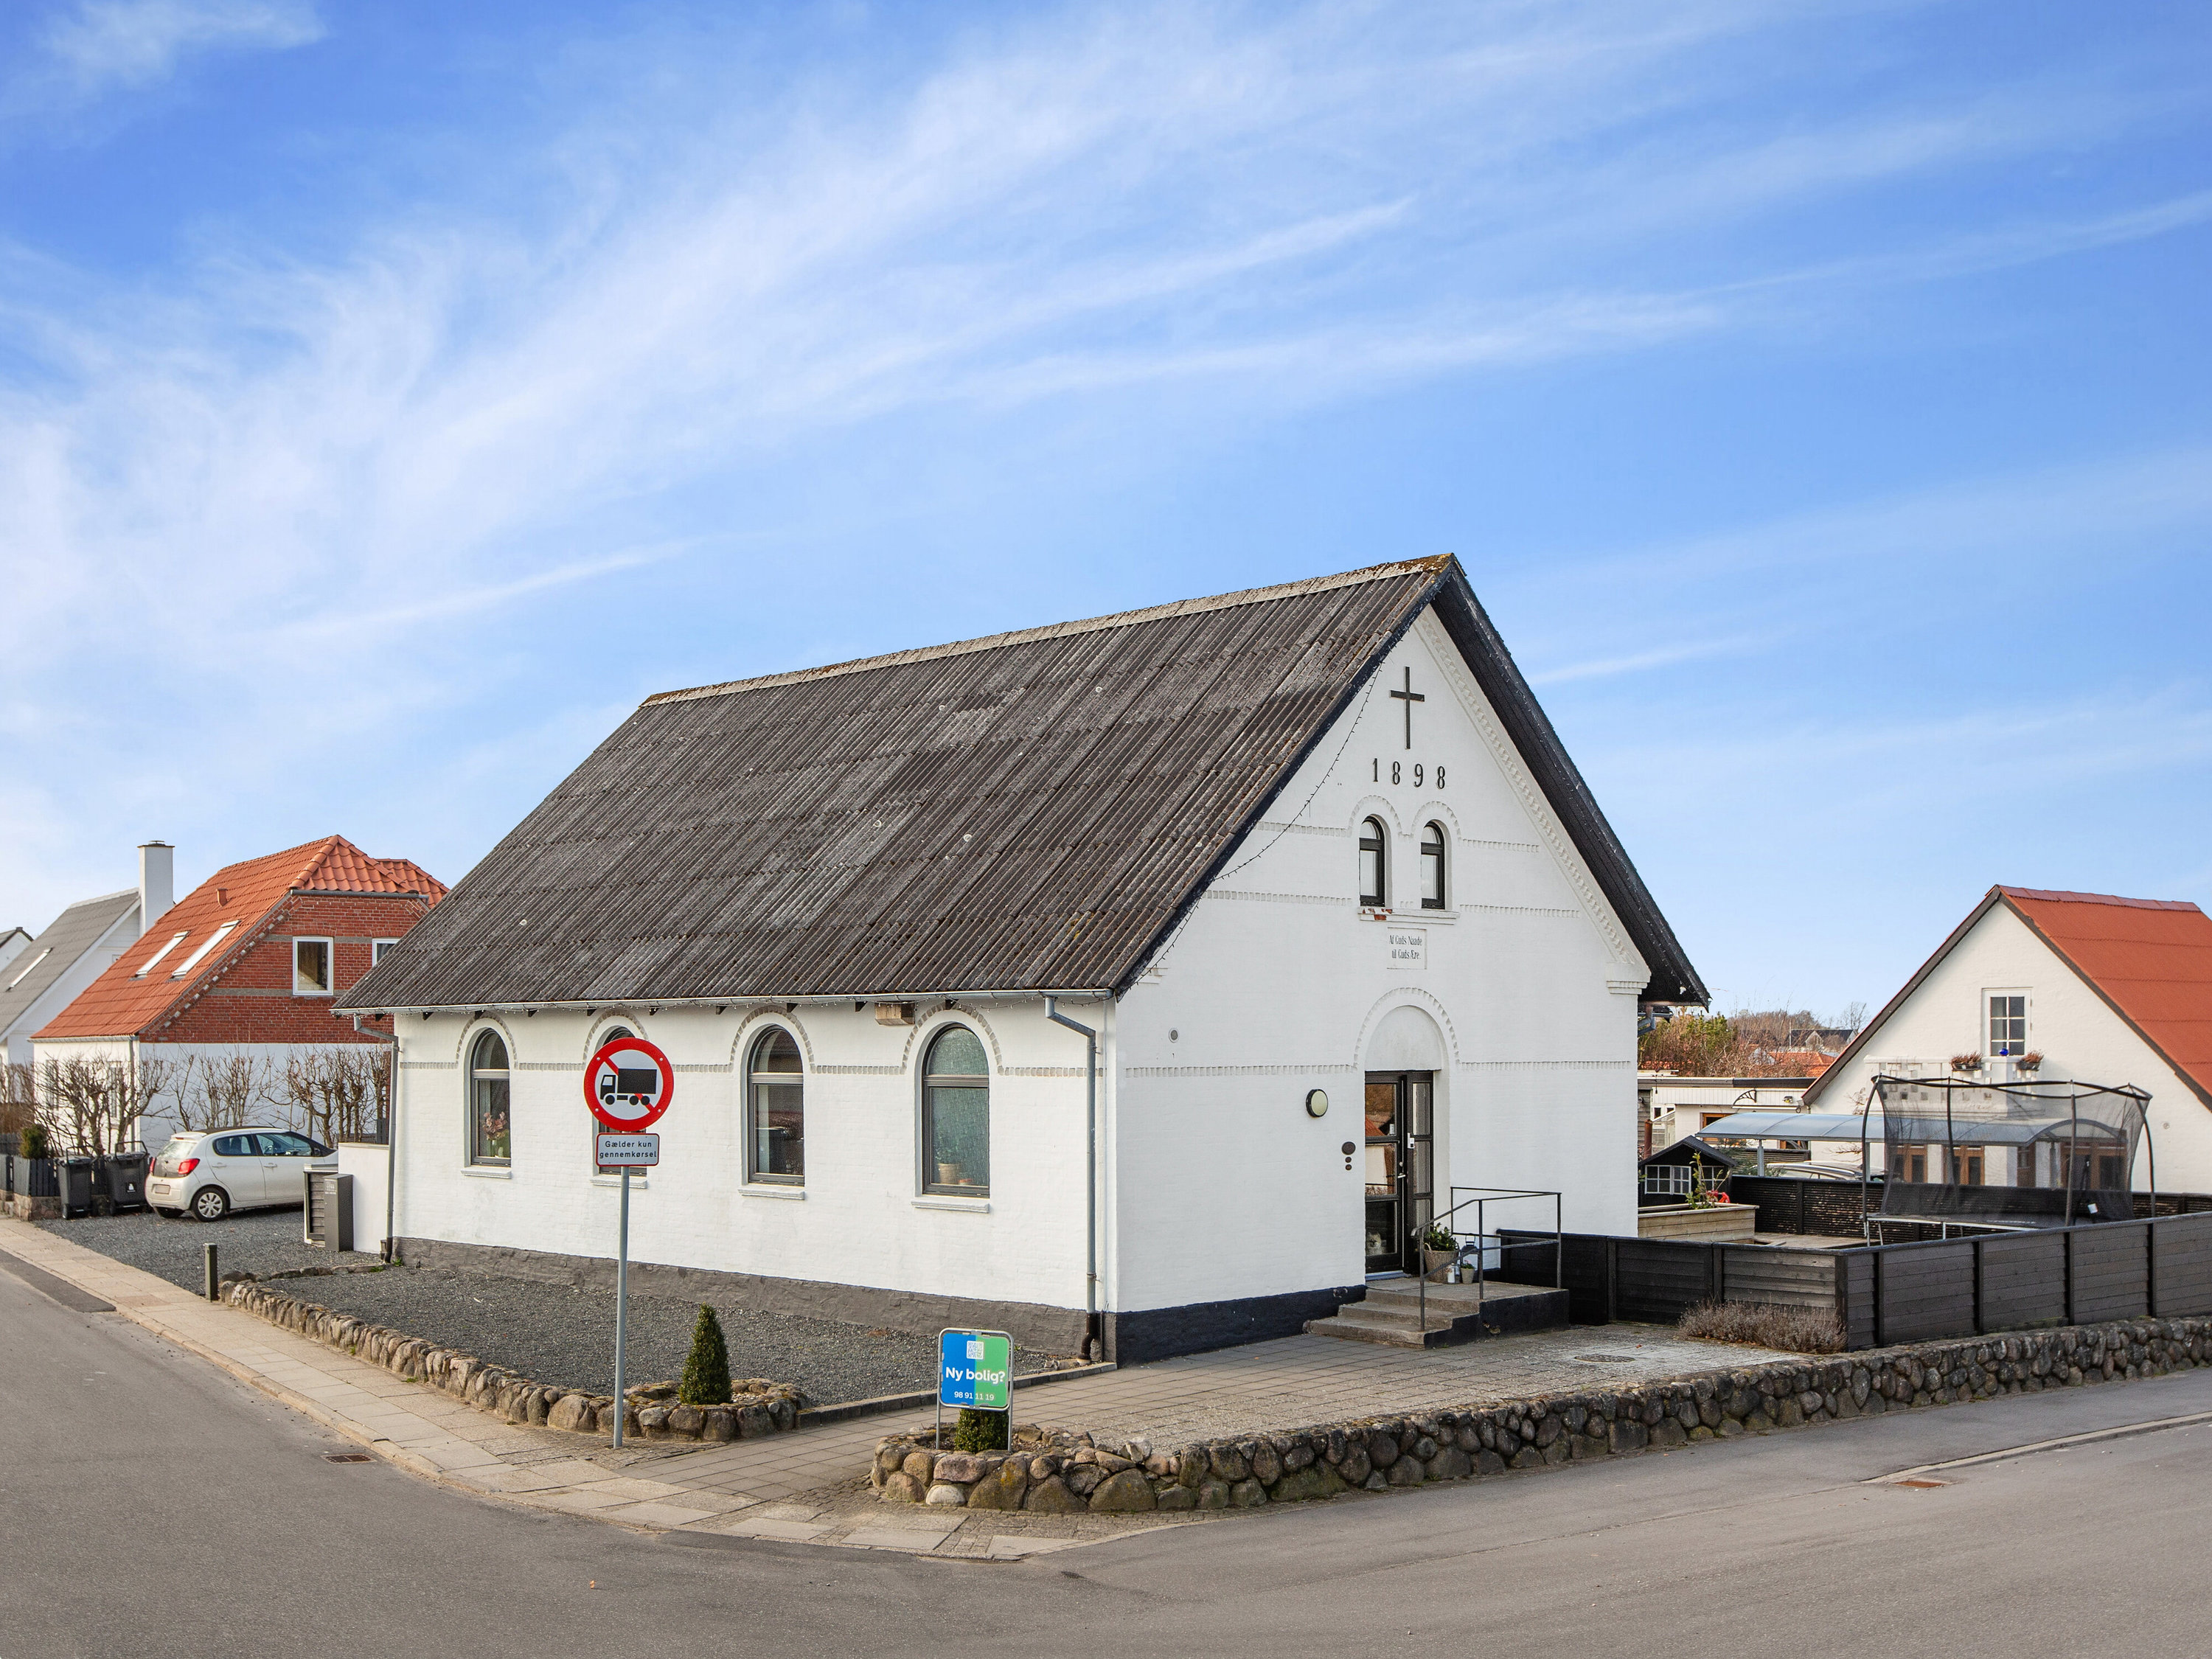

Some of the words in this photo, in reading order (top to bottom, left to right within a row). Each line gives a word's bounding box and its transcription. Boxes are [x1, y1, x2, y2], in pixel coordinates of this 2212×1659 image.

[1372, 758, 1445, 790] 1898
[945, 1366, 963, 1381] Ny
[966, 1368, 1005, 1385] bolig?
